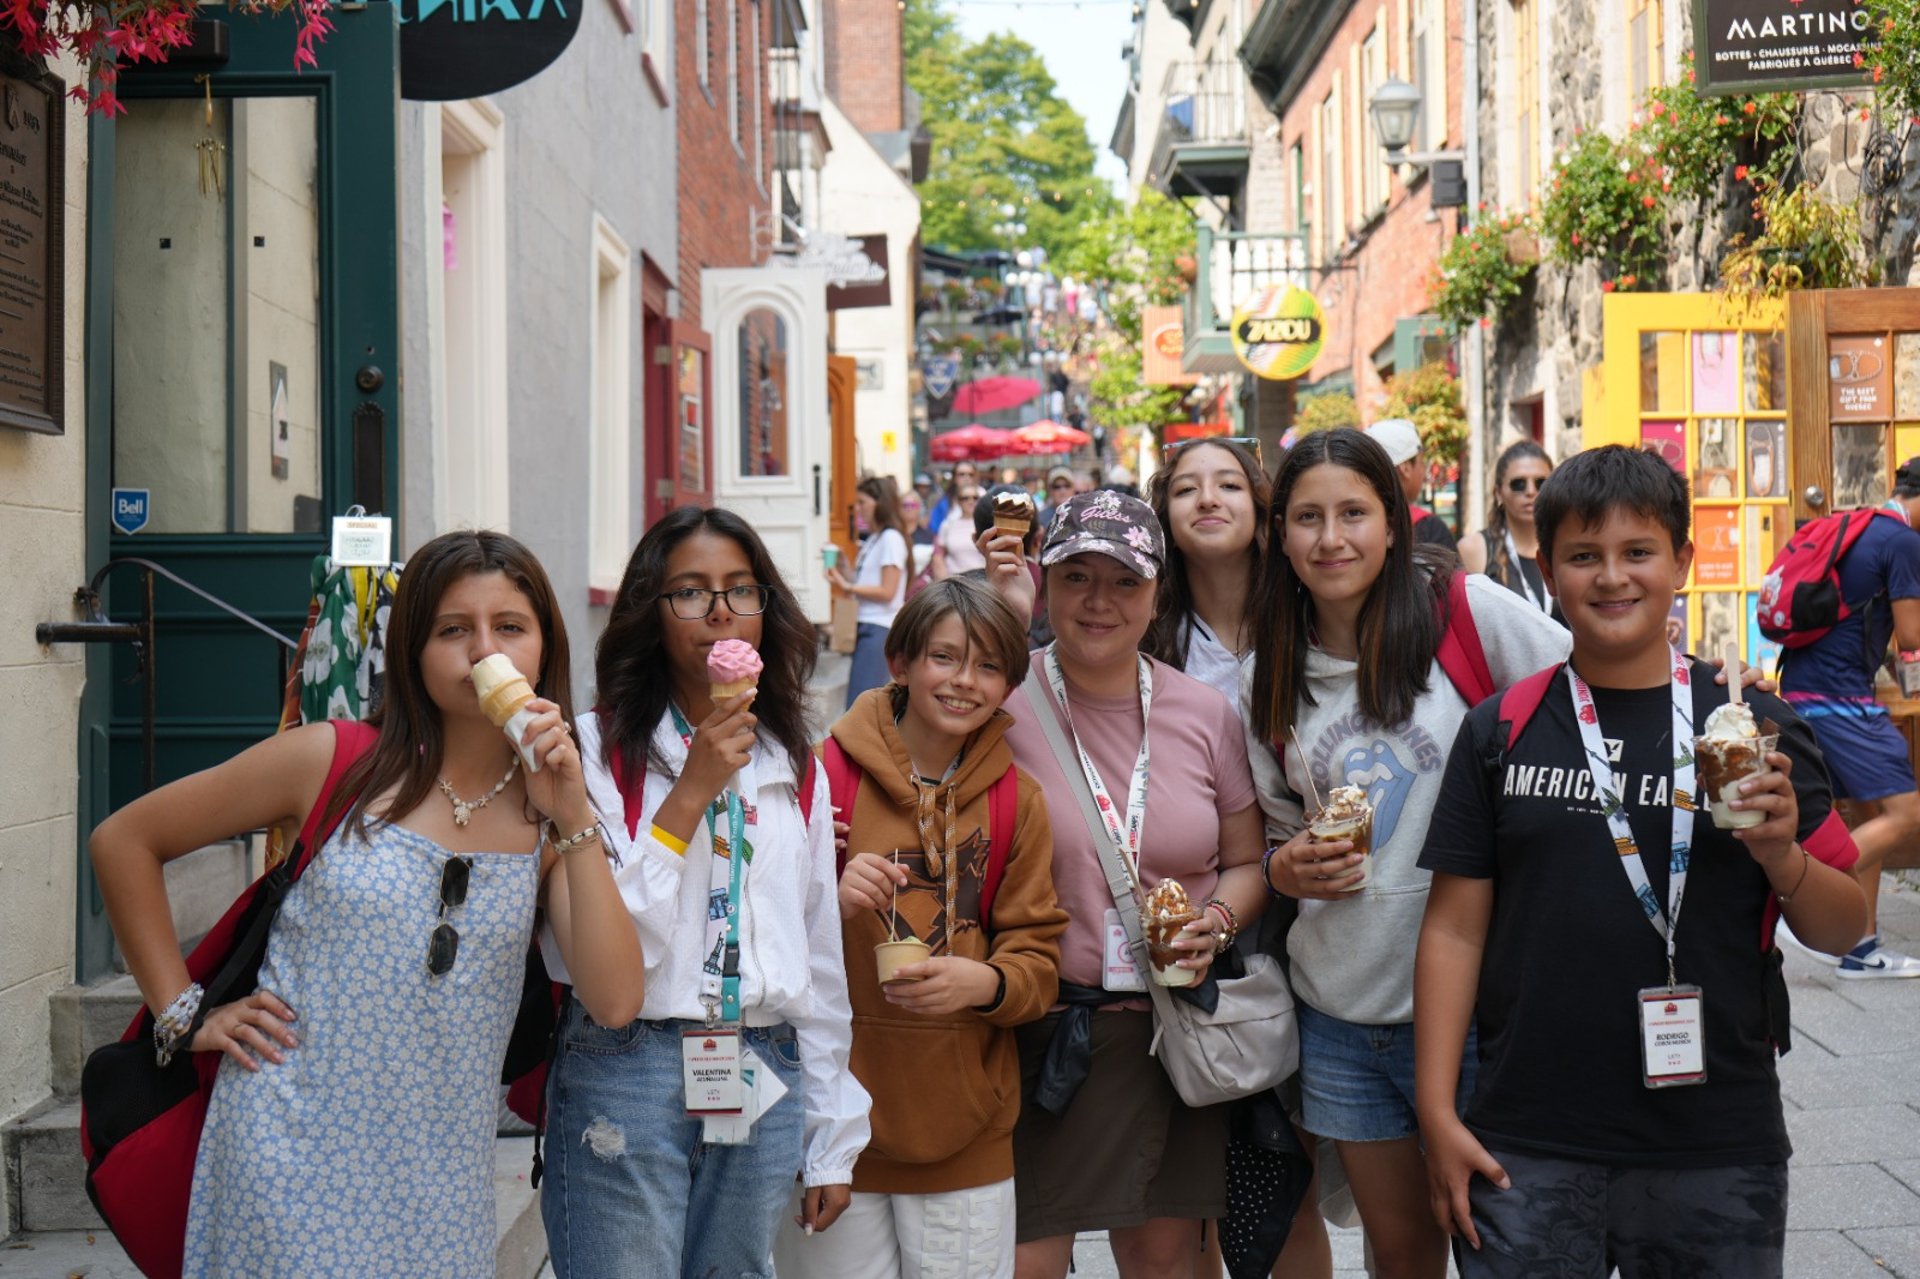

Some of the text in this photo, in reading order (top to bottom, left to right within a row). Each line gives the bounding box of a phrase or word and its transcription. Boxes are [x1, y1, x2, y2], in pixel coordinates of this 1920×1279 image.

[1726, 9, 1870, 41] MARTINO
[1715, 50, 1751, 61] BOTTES
[1758, 46, 1820, 59] CHAUSSURES
[1247, 319, 1311, 342] ZAZOU
[119, 499, 143, 514] Bell
[1080, 505, 1131, 523] Guess
[1656, 1032, 1689, 1041] RODRIGO
